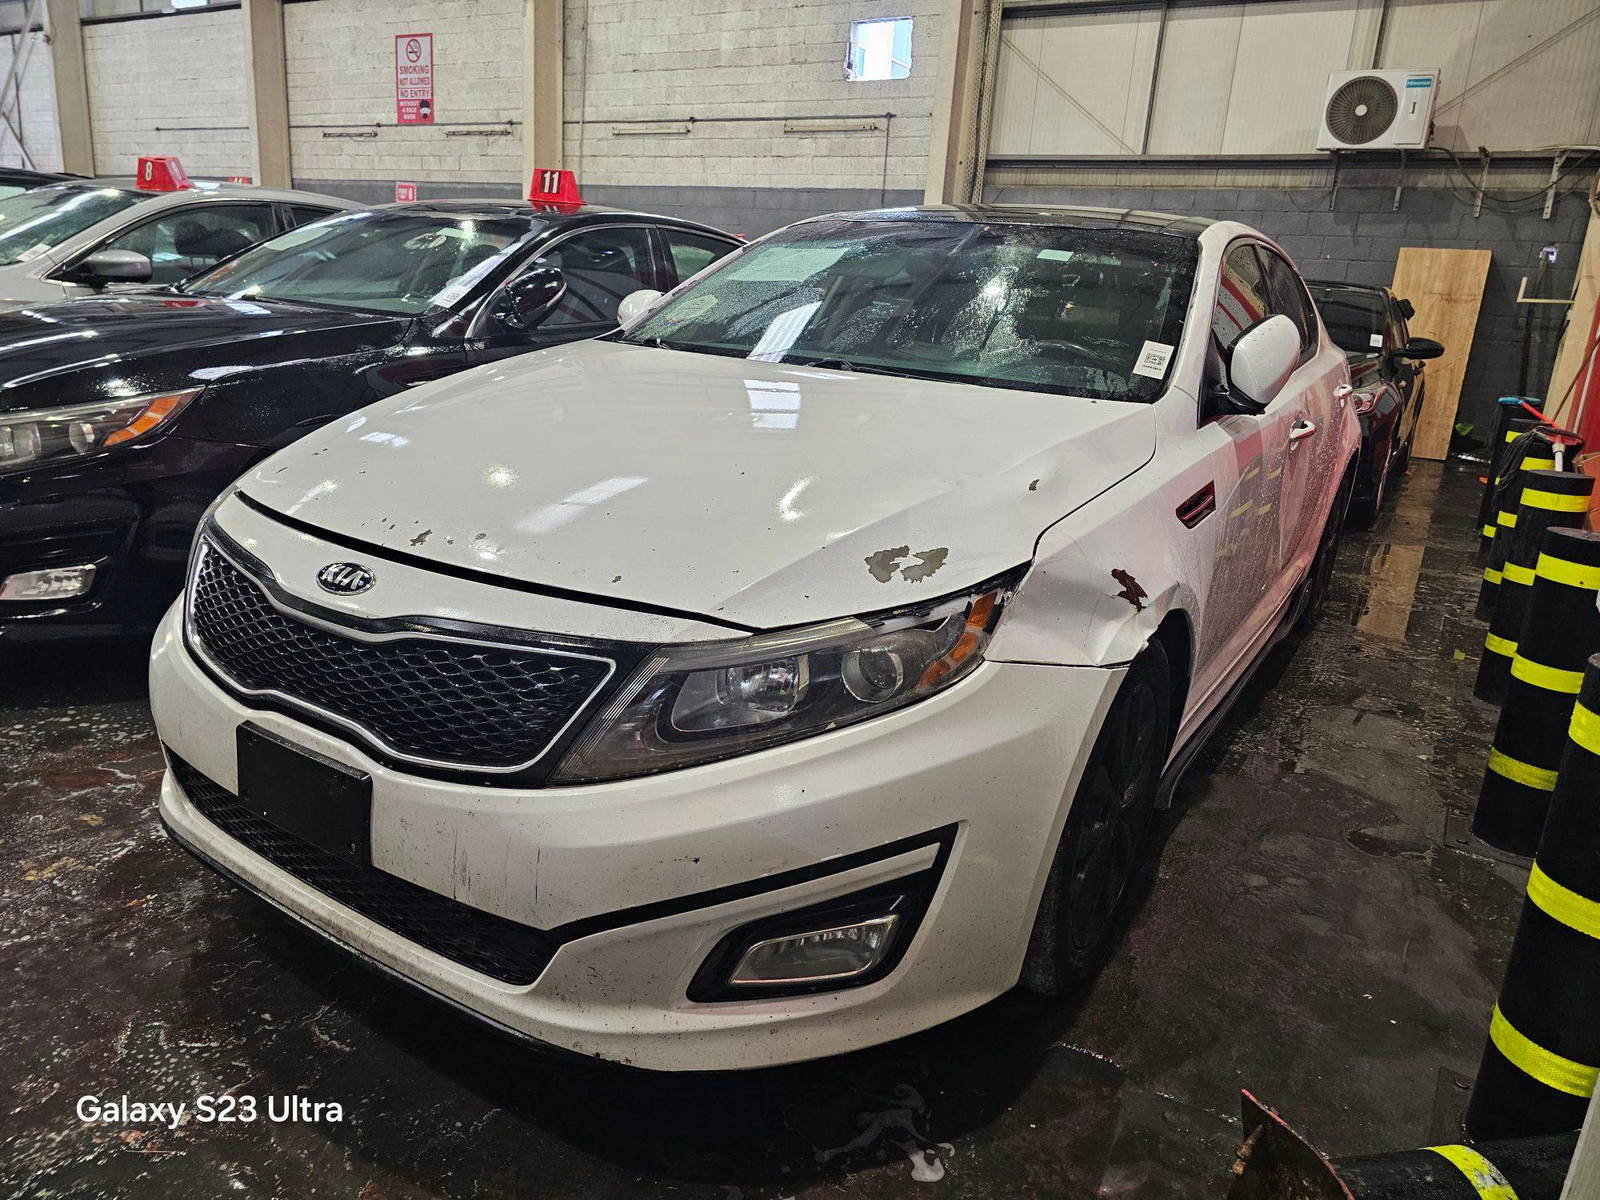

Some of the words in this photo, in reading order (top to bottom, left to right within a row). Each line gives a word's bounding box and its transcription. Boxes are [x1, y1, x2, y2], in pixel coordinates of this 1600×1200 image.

[400, 65, 429, 74] SMOKING
[410, 77, 430, 85] ALLOWED
[400, 90, 409, 98] NO
[410, 89, 430, 98] ENTRY
[145, 161, 153, 181] 8
[543, 171, 559, 194] 11
[319, 563, 366, 591] KIA
